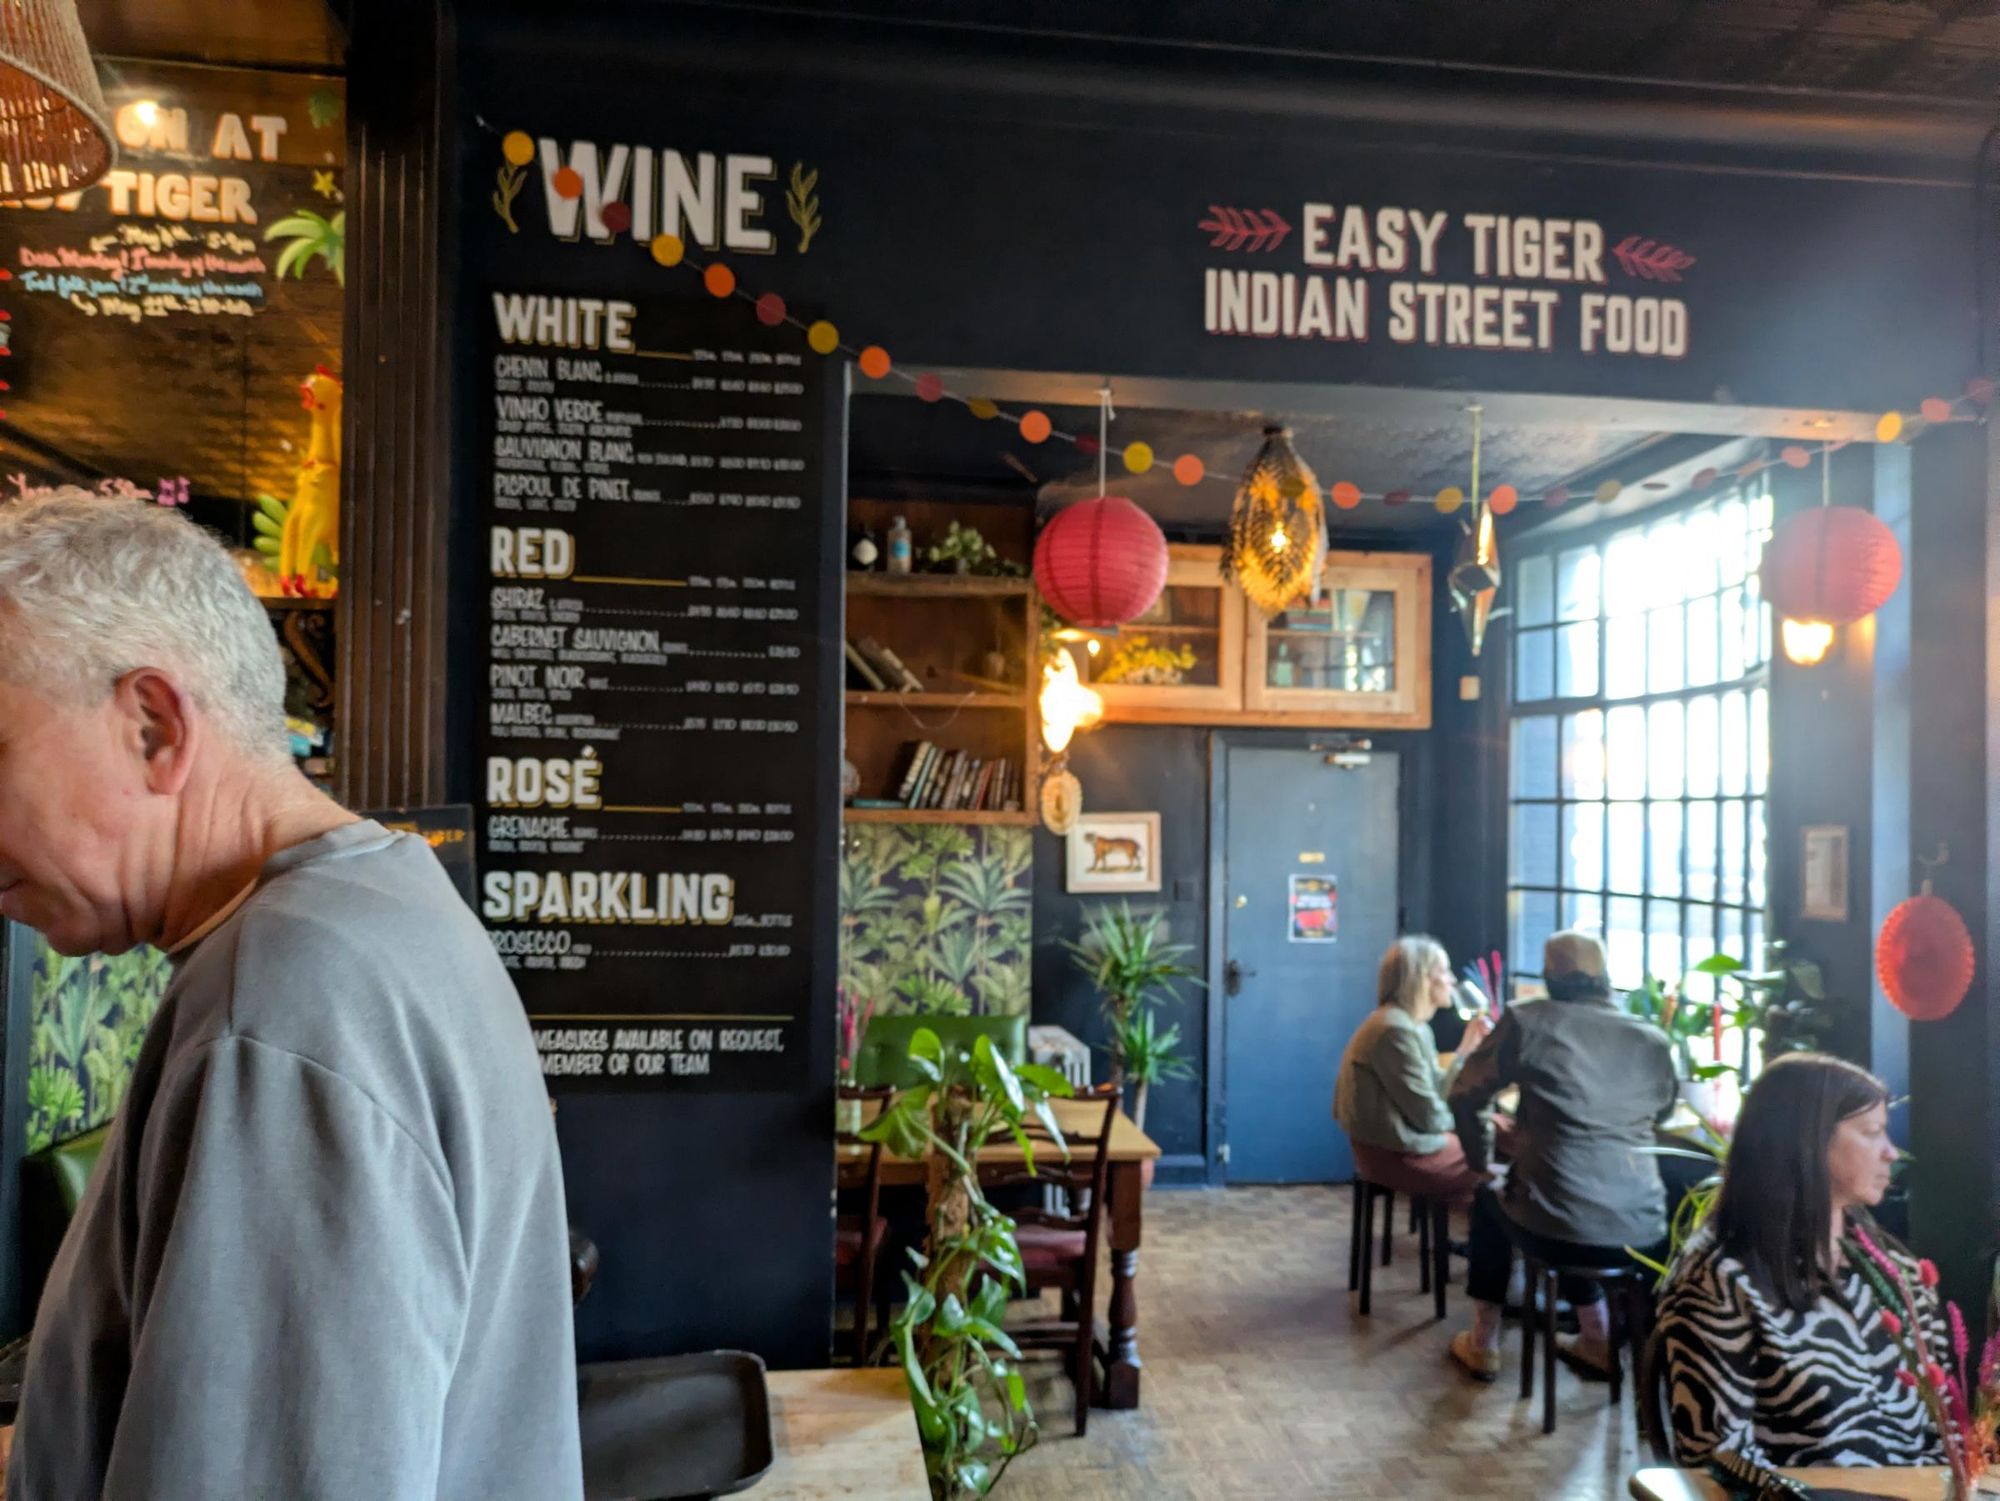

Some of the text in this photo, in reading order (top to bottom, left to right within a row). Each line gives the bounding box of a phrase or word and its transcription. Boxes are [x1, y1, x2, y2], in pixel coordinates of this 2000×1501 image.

[212, 113, 287, 161] AT
[101, 170, 258, 225] TIGER
[538, 137, 777, 254] WINE
[1303, 203, 1605, 283] EASY TIGER
[493, 292, 637, 351] WHITE
[1204, 268, 1689, 359] INDIAN STREET FOOD
[556, 357, 603, 383] BLANC
[495, 395, 549, 421] VINHO
[553, 400, 604, 424] VERDE
[562, 476, 583, 499] DE
[490, 526, 576, 579] RED
[490, 587, 545, 610] SHIRAZ
[490, 625, 568, 649] CABERNET
[573, 628, 661, 653] SAUVIGNON
[490, 664, 538, 689] PINOT
[545, 666, 586, 690] NOIR
[490, 703, 553, 726] MALBEC
[487, 745, 603, 808] ROSÉ
[488, 816, 570, 840] GRENACHE
[483, 871, 735, 925] SPARKLING
[613, 1029, 685, 1051] AVAILABLE
[688, 1029, 713, 1051] ON
[607, 1053, 630, 1075] OF
[634, 1053, 665, 1075] OUR
[670, 1053, 710, 1075] TEAM
